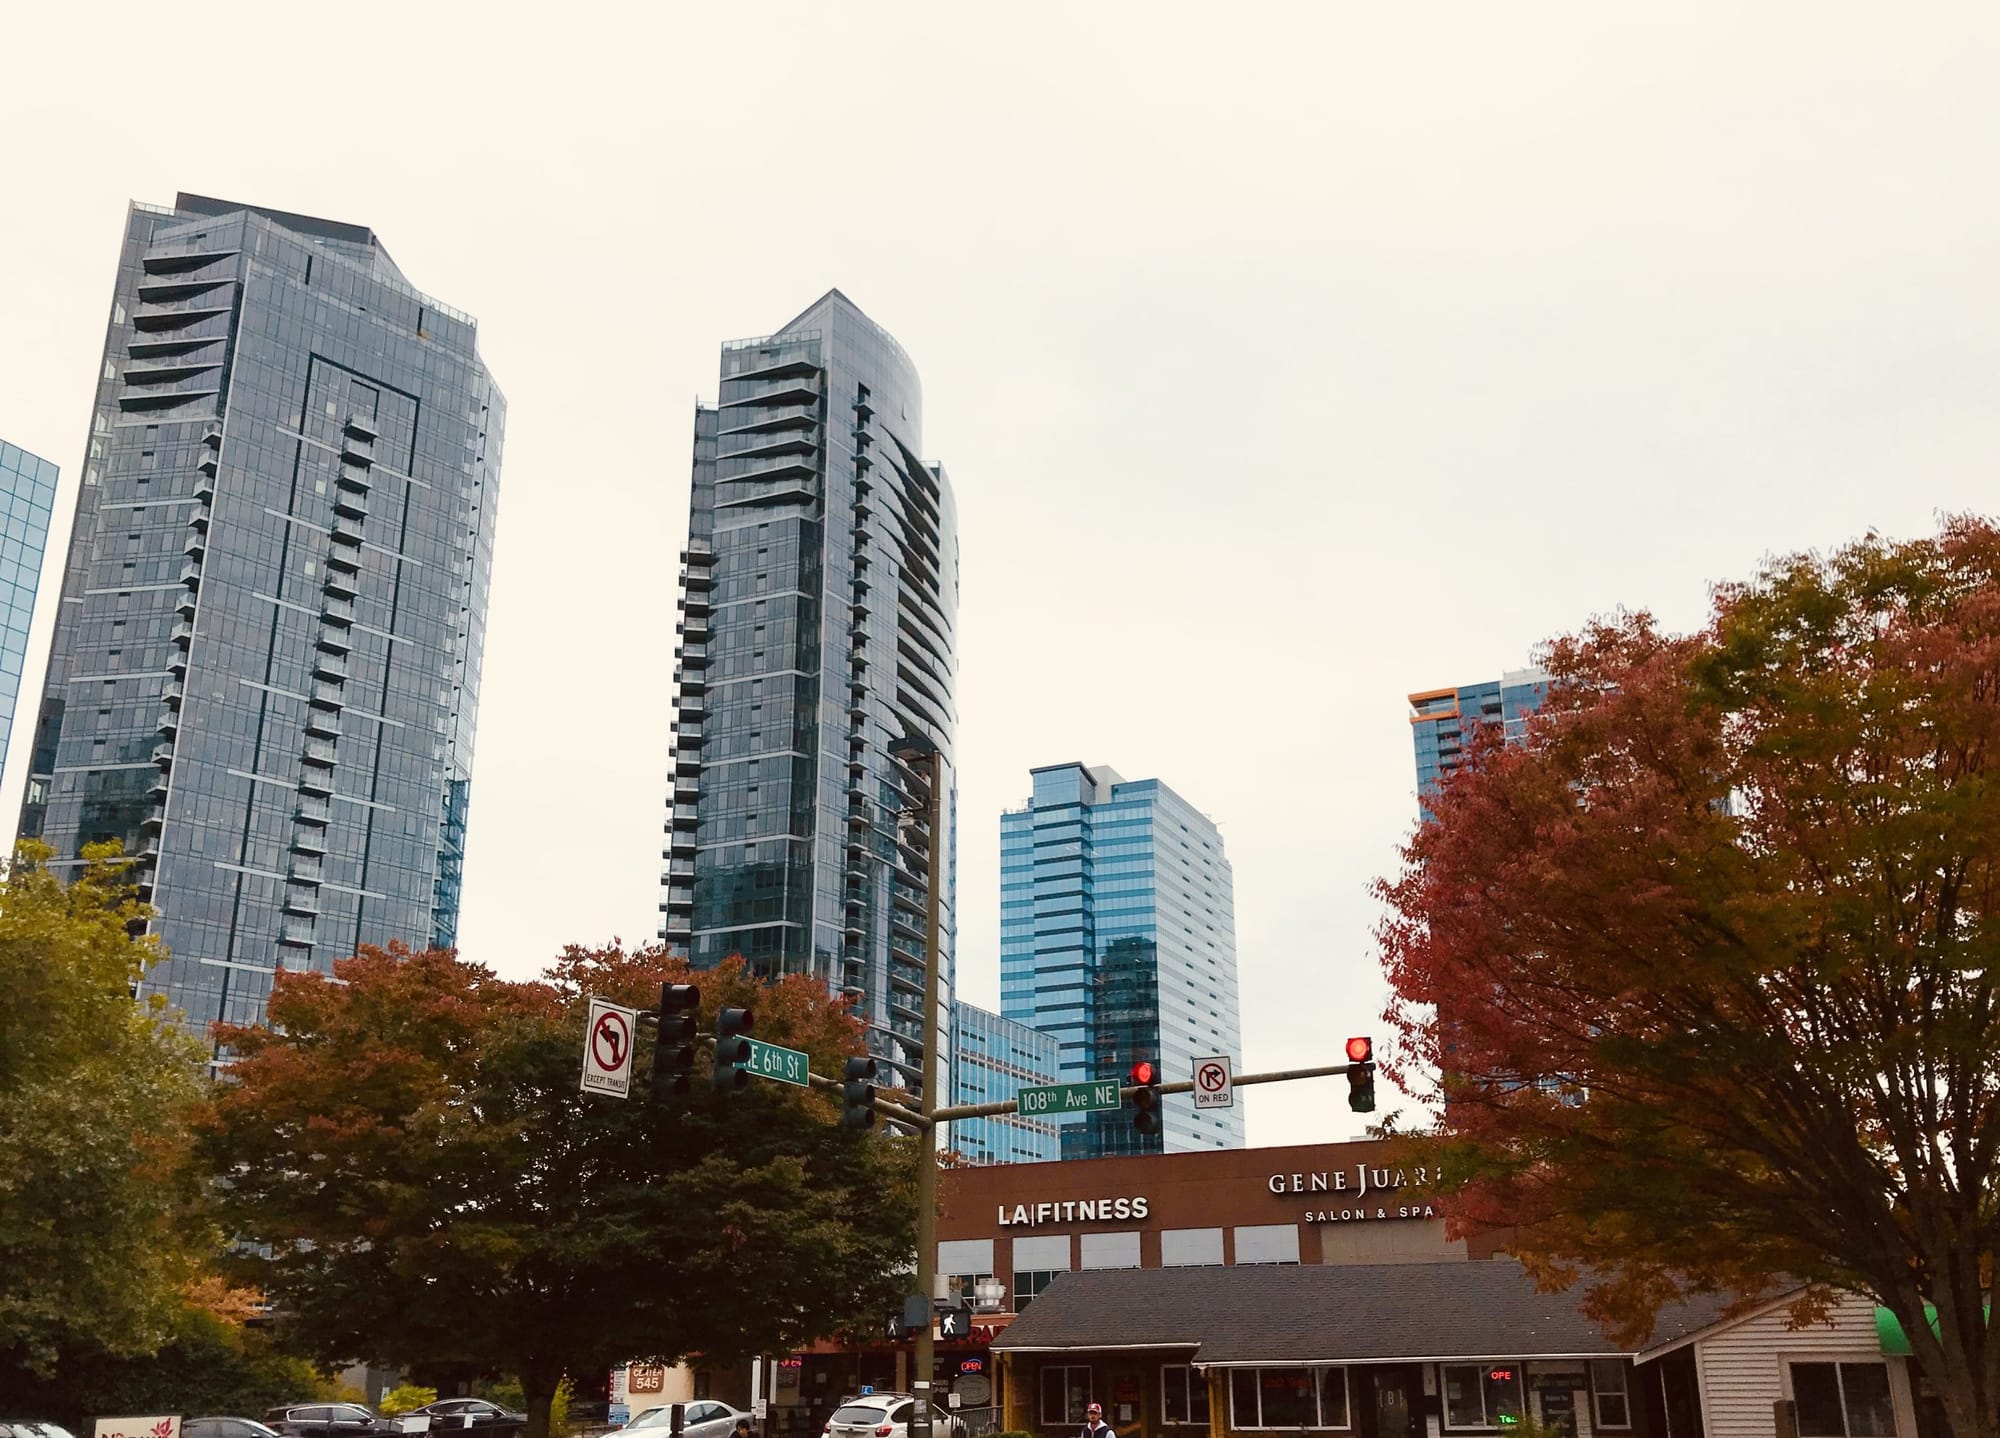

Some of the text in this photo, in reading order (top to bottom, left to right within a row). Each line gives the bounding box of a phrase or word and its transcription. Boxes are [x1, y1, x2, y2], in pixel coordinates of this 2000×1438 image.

[764, 1049, 783, 1073] 6th
[787, 1054, 800, 1080] St
[587, 1073, 626, 1089] EXCEPT TRANSIT
[1023, 1085, 1115, 1111] 108th Ave NE
[1198, 1093, 1229, 1103] ON RED
[1268, 1171, 1347, 1193] GENE
[1305, 1205, 1434, 1222] SALON & SPA
[961, 1360, 982, 1371] OPEN
[636, 1377, 659, 1389] 545
